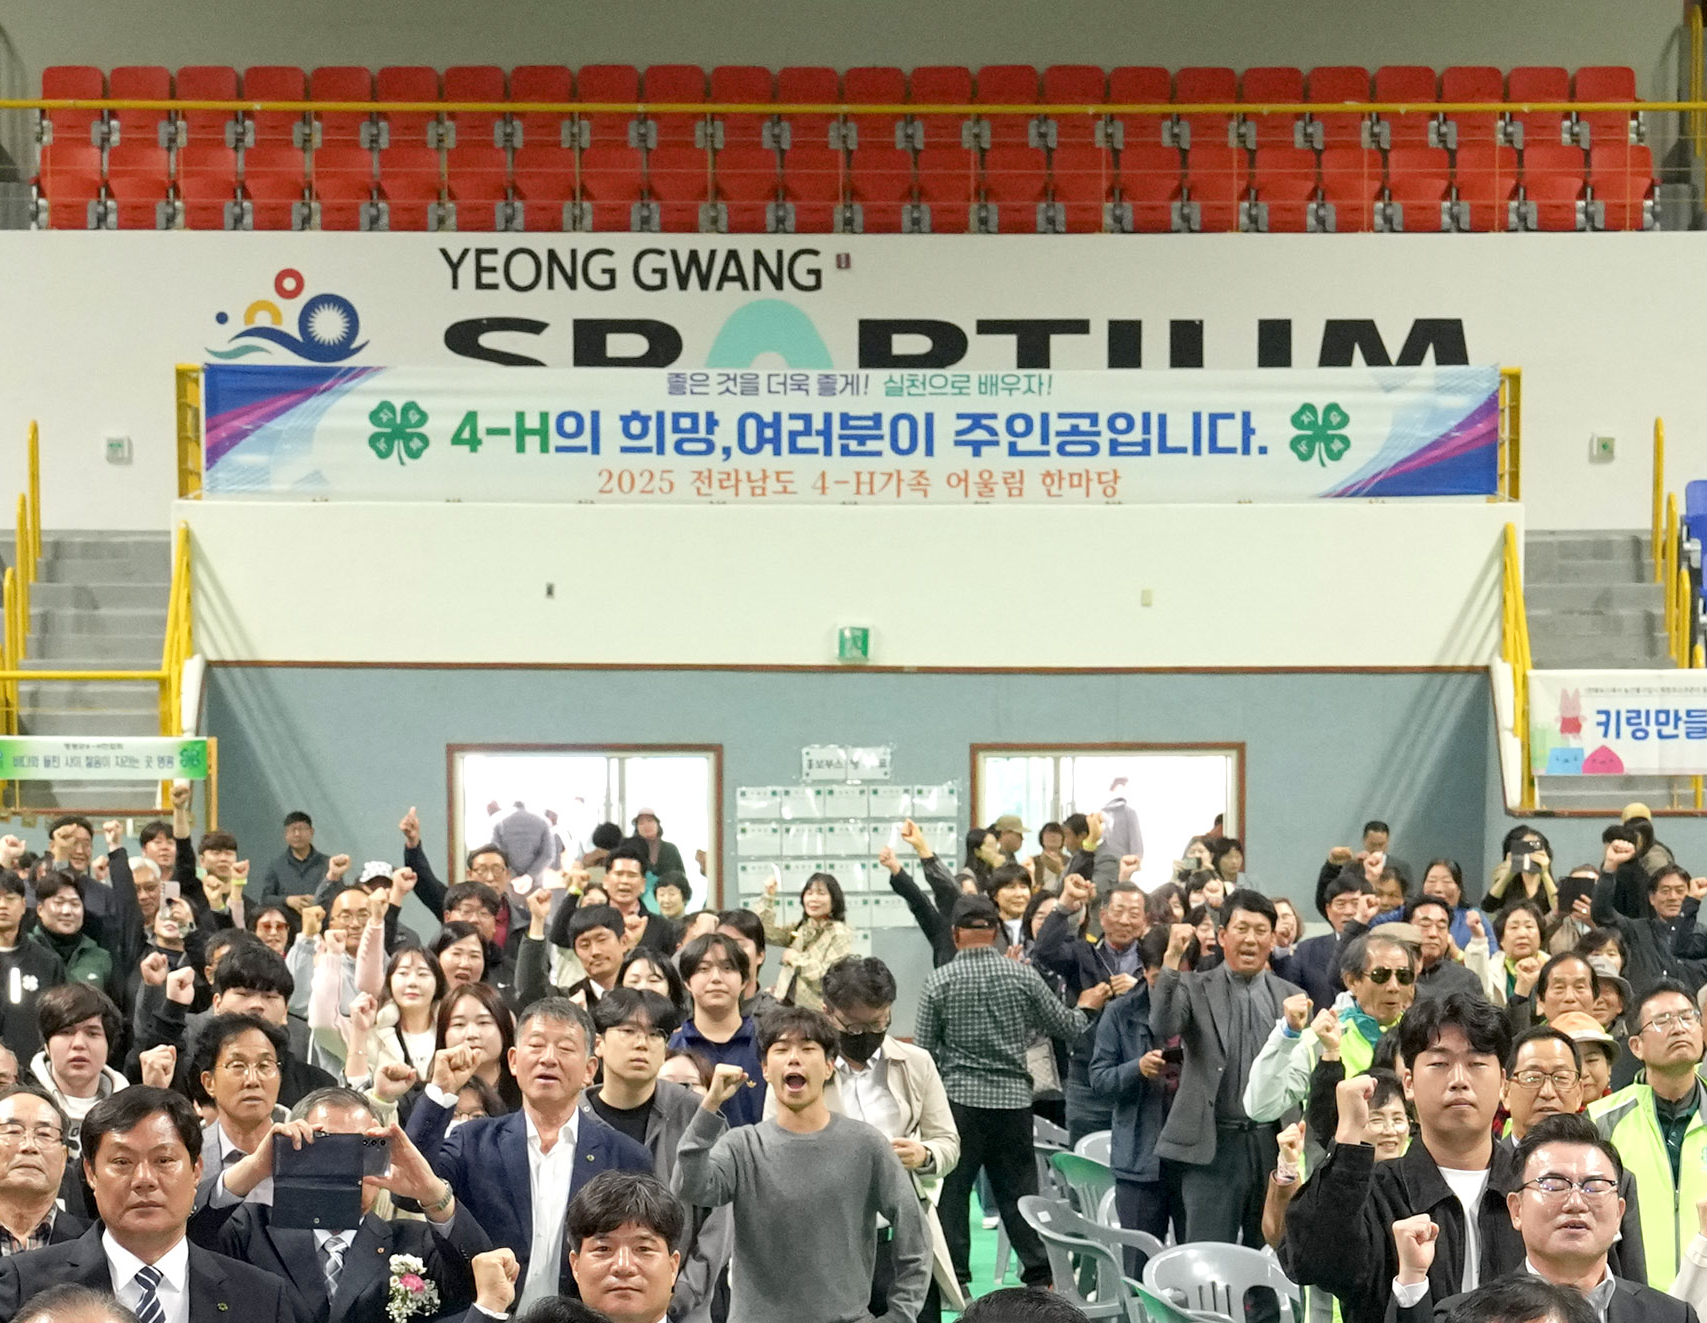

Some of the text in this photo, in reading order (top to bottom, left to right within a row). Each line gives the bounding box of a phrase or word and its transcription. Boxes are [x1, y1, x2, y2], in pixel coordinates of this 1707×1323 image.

[438, 247, 824, 292] YEONG GWANG
[666, 373, 1053, 398] 좋은 것을 더욱 좋게! 실천으로 배우자!
[450, 410, 1268, 463] 4-H의 희망,여러분이 주인공입니다.
[597, 467, 1123, 499] 2025 전라남도 4-H가족 어울림 한마당
